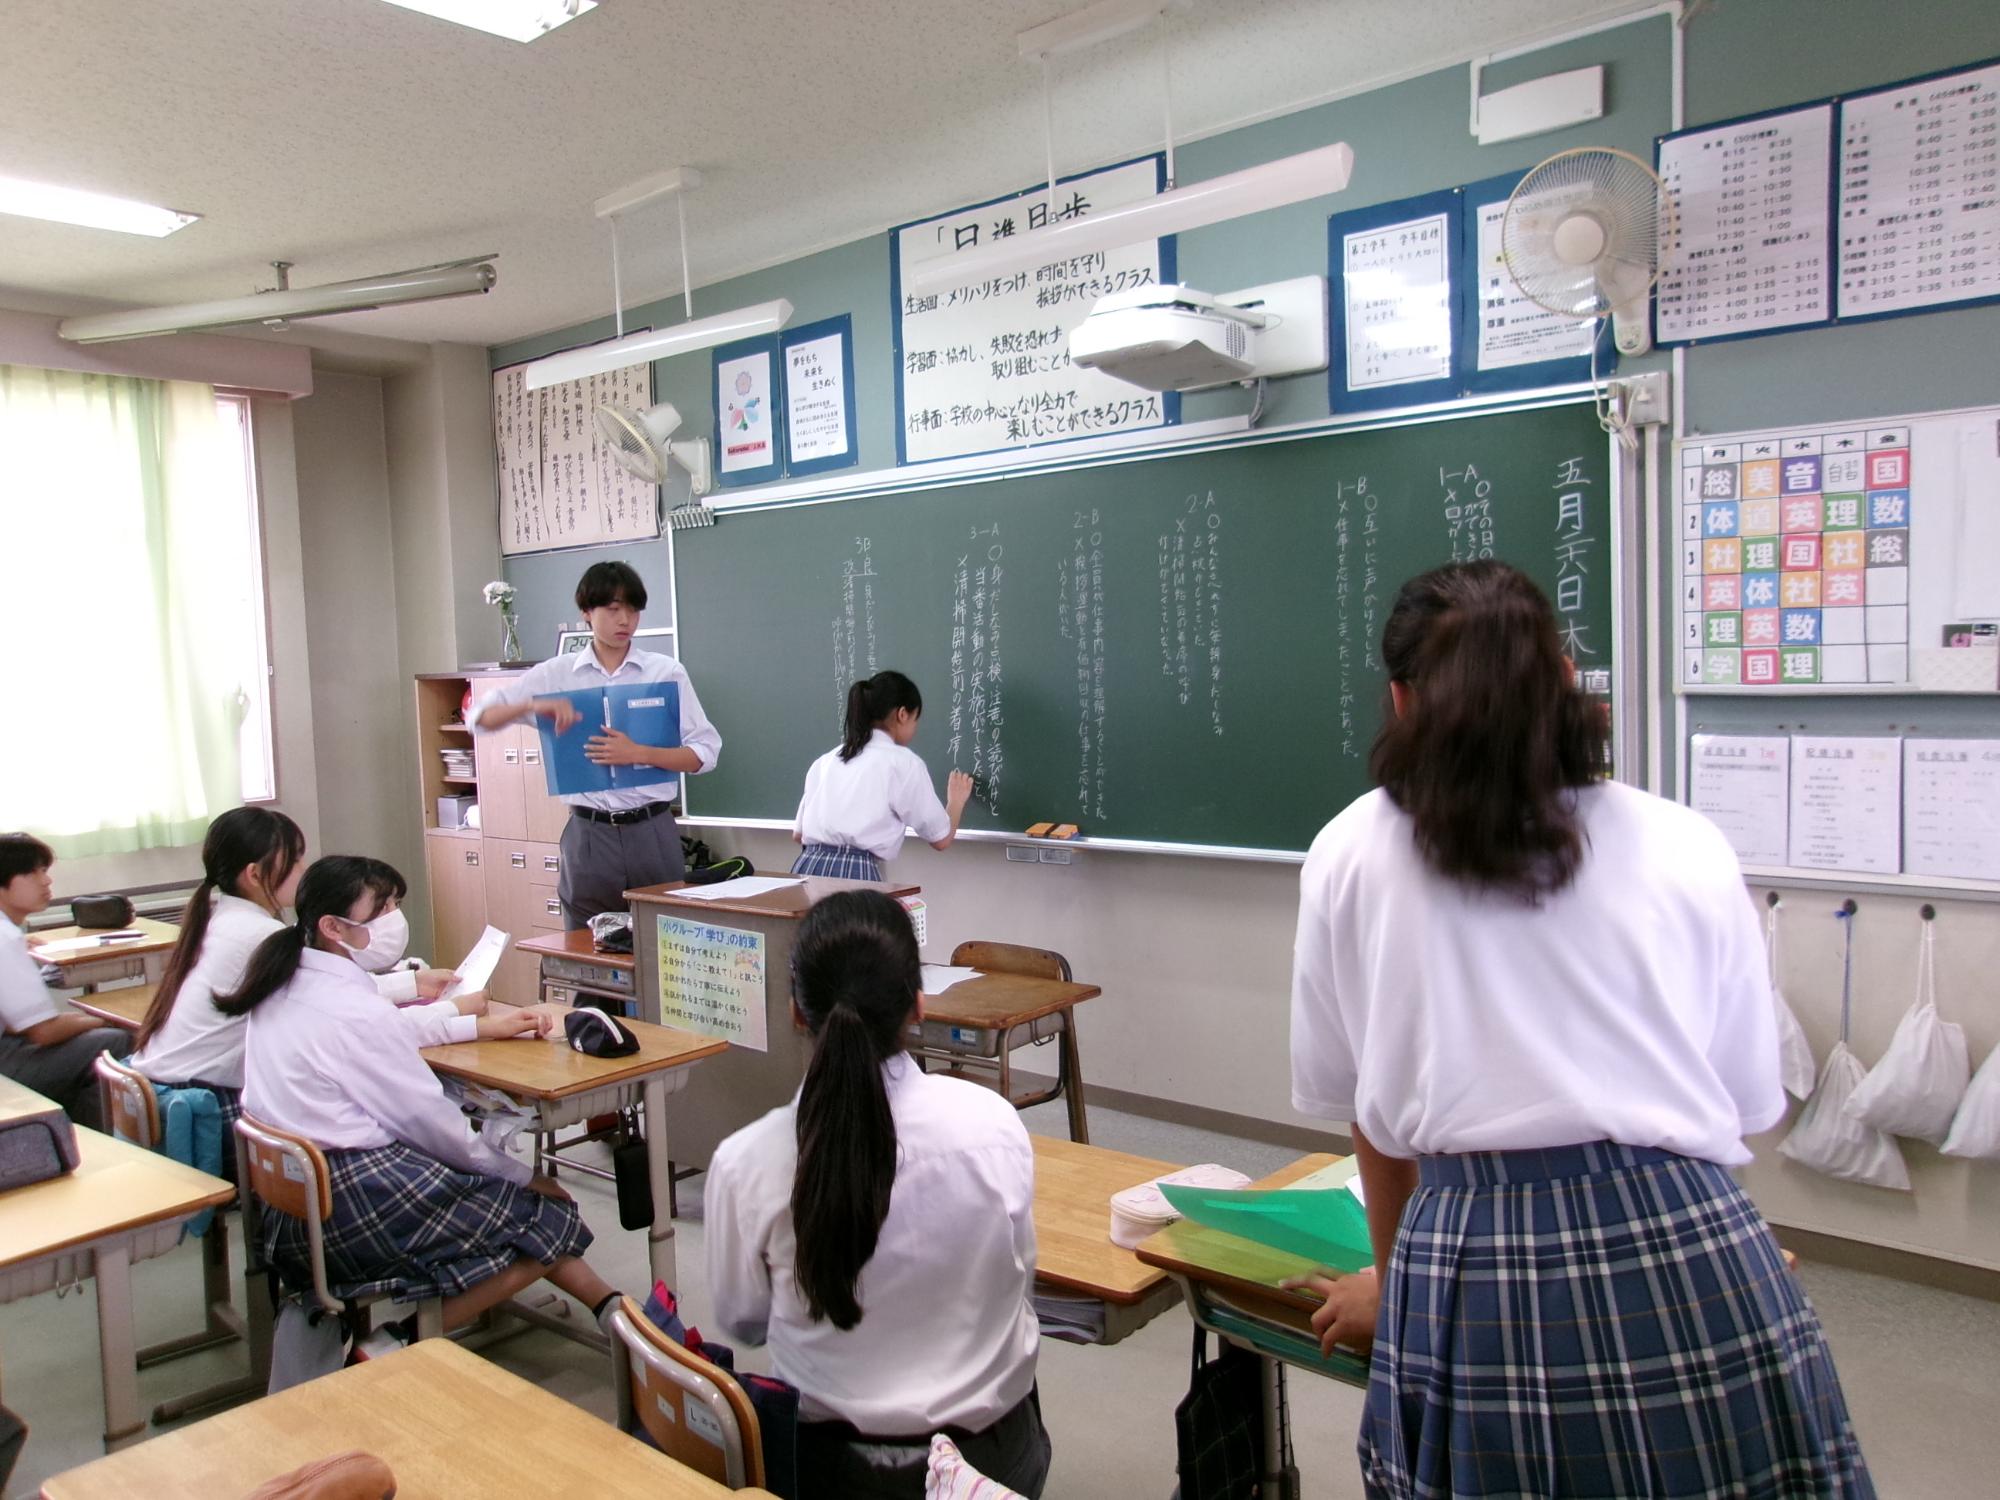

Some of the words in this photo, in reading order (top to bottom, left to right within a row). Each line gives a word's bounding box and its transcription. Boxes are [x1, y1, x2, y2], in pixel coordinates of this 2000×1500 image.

[1713, 449, 1726, 457] 月
[1690, 477, 1694, 490] 1
[1704, 469, 1732, 496] 総
[1748, 466, 1773, 493] 美
[1785, 462, 1816, 490] 音
[1872, 456, 1903, 483] 国
[1690, 514, 1696, 529] 2
[1706, 507, 1734, 533] 体
[1747, 505, 1772, 531] 道
[1785, 501, 1817, 528] 英
[1826, 499, 1857, 526] 理
[1873, 496, 1904, 525] 数
[1689, 552, 1695, 565] 3
[1709, 544, 1736, 569] 社
[1746, 543, 1774, 568] 理
[1785, 539, 1817, 566] 国
[1828, 537, 1859, 565] 社
[1871, 535, 1901, 563] 総
[1688, 587, 1694, 600] 4
[1708, 579, 1735, 606] 英
[1746, 578, 1774, 605] 体
[1785, 576, 1816, 604] 社
[1827, 574, 1857, 601] 英
[1690, 625, 1696, 638] 5
[1708, 617, 1737, 643] 理
[1747, 613, 1775, 640] 英
[1785, 612, 1816, 641] 数
[1692, 660, 1698, 674] 6
[1707, 654, 1734, 680] 学
[1746, 654, 1777, 681] 国
[1783, 652, 1814, 680] 理
